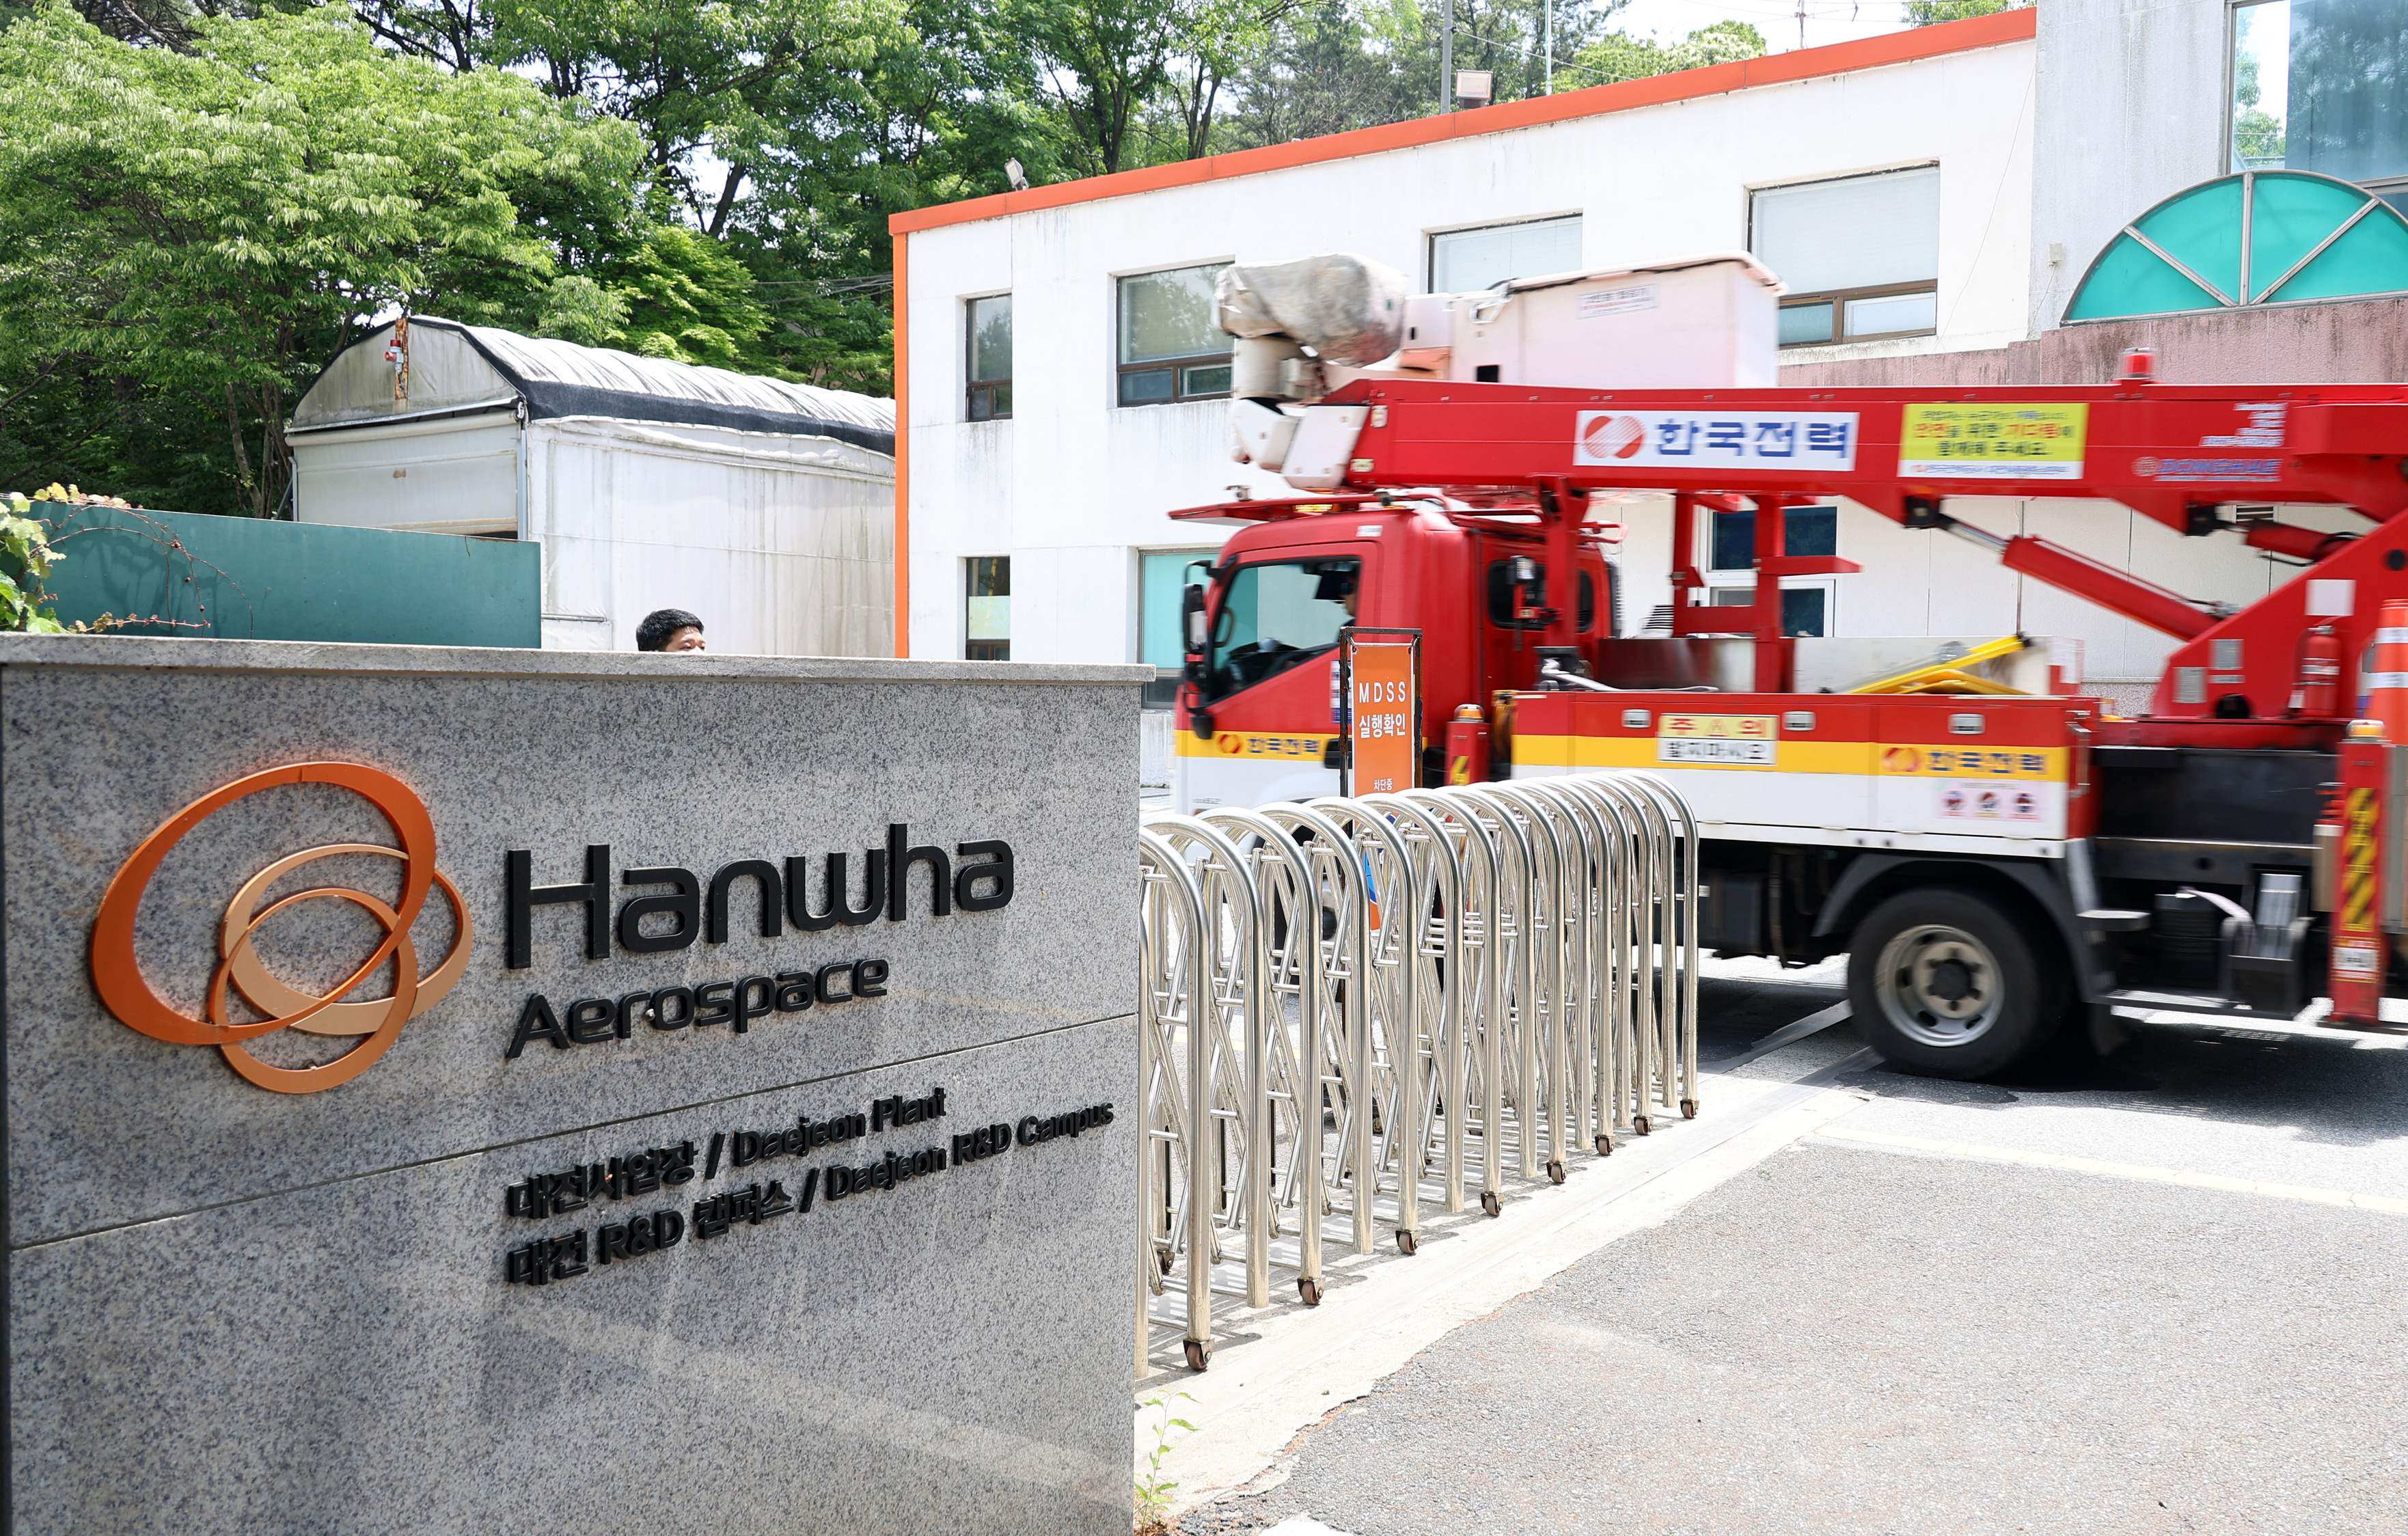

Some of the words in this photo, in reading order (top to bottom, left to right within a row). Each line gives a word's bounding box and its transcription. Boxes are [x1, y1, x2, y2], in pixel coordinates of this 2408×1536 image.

[1655, 418, 1852, 459] 한국전력
[1359, 681, 1406, 703] MDSS
[1358, 713, 1406, 739] 실행확인
[1247, 738, 1321, 756] 한국전력
[1928, 751, 2049, 775] 한국전력
[1373, 778, 1393, 791] 차단중
[507, 823, 1014, 970] Hanwha
[505, 959, 889, 1058] Aerospace
[508, 1139, 698, 1219] 대전사업장
[705, 1132, 725, 1180] /
[733, 1112, 866, 1168] Daejeon
[873, 1087, 946, 1132] Plant
[508, 1229, 589, 1286] 대전
[599, 1209, 684, 1265] R&D
[694, 1179, 795, 1240] 캠퍼스
[799, 1166, 820, 1213] /
[826, 1146, 947, 1201] Daejeon
[953, 1123, 1013, 1166] R&D
[1017, 1102, 1114, 1148] Campus
